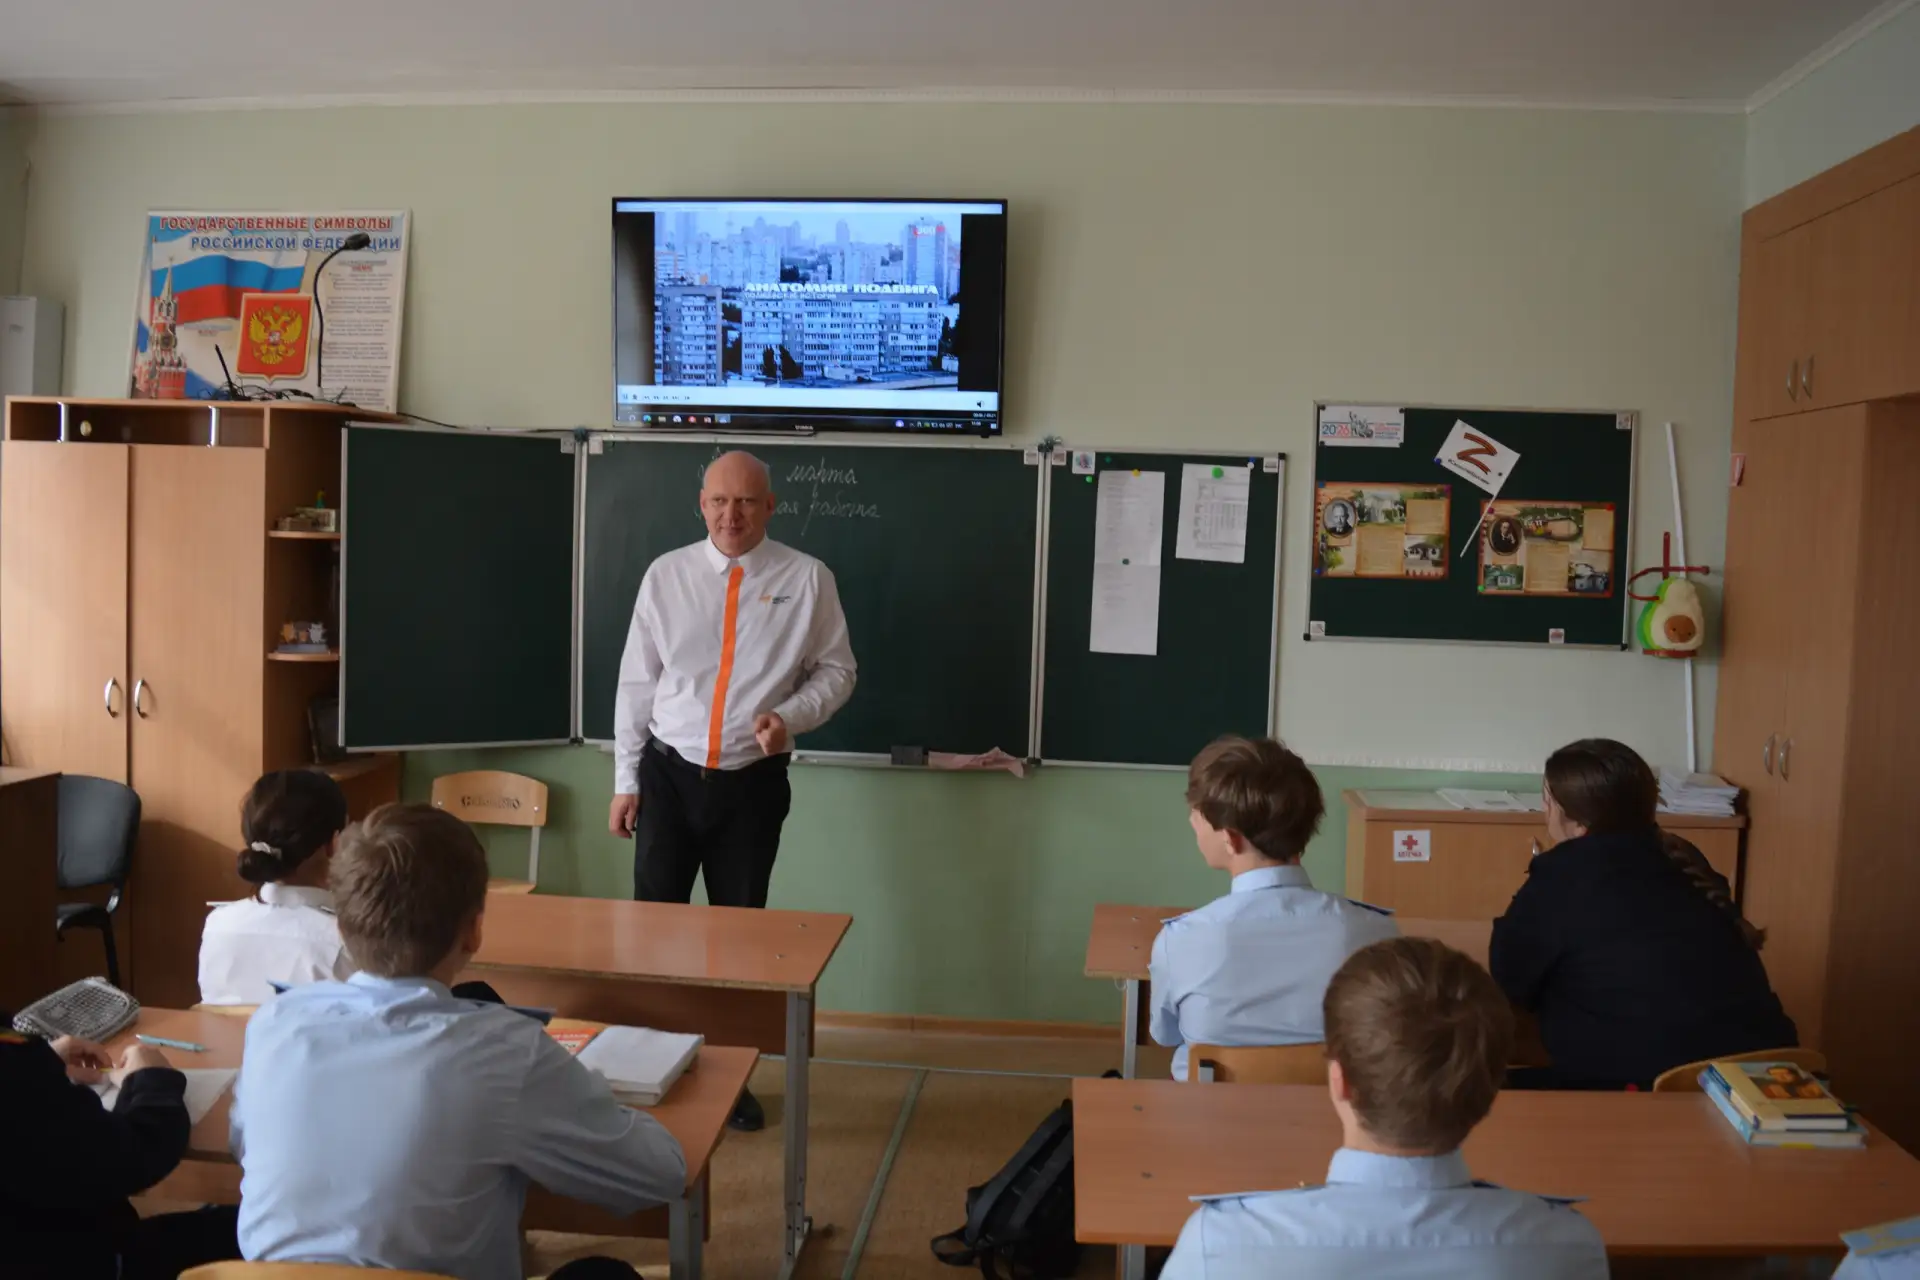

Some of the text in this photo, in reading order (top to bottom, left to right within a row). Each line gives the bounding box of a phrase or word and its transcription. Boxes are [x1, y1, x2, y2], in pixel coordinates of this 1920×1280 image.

[160, 216, 392, 231] ГОСУДАРСТВЕННЫЕ СИМВОЛЫ
[302, 235, 400, 250] ФЕДЕЦИИ
[744, 282, 939, 295] АНАТОМИЯ ПОДВИГА
[1456, 432, 1498, 475] Z
[786, 456, 859, 498] марта
